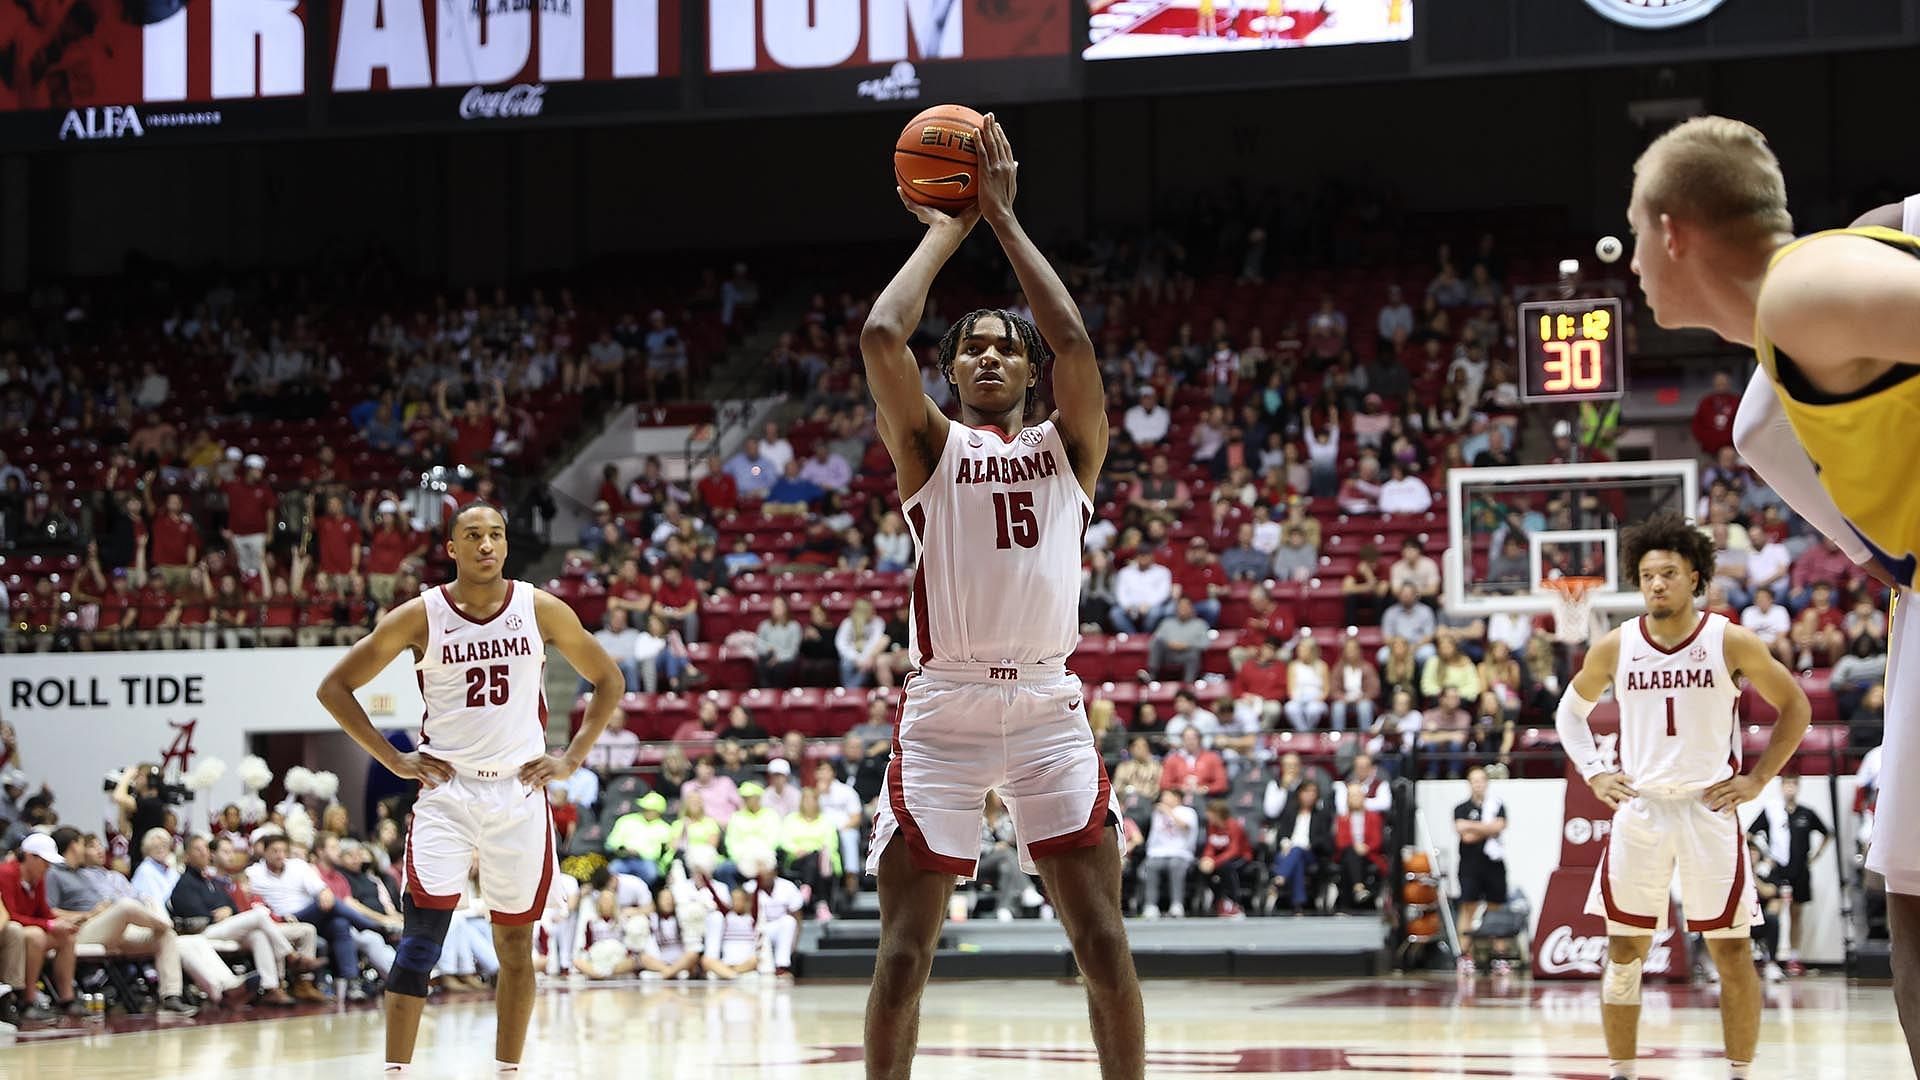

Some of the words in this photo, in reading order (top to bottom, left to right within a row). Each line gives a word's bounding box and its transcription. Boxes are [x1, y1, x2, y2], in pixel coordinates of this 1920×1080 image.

[59, 104, 144, 140] ALFA
[1542, 340, 1602, 392] 30
[1021, 430, 1043, 445] SEC
[956, 450, 1057, 484] ALABAMA
[992, 491, 1039, 549] 15
[442, 636, 531, 664] ALABAMA
[465, 664, 510, 708] 25
[989, 667, 1018, 680] RTR
[1627, 669, 1715, 690] ALABAMA
[10, 677, 110, 708] ROLL
[120, 675, 205, 706] TIDE
[1665, 697, 1677, 736] 1
[1538, 925, 1676, 974] Cocala
